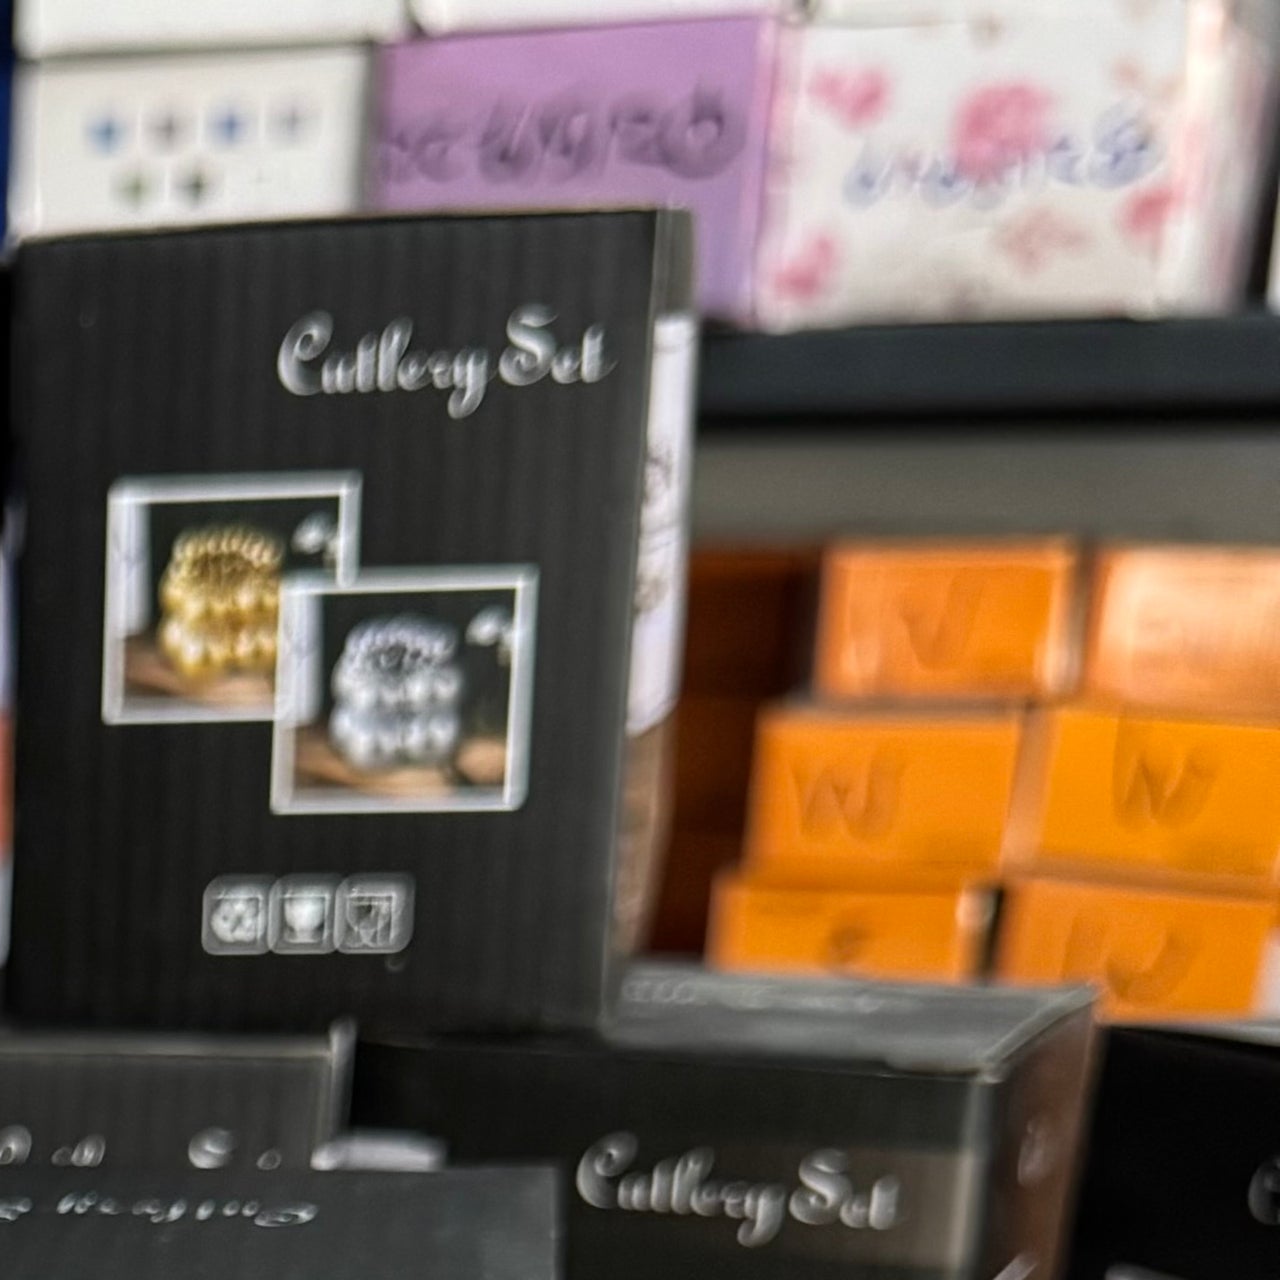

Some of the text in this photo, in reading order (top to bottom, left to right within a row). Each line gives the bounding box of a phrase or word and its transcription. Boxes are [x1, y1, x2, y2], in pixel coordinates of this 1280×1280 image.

[277, 303, 618, 420] Cutlery Set
[576, 1129, 904, 1248] Cutlery Set
